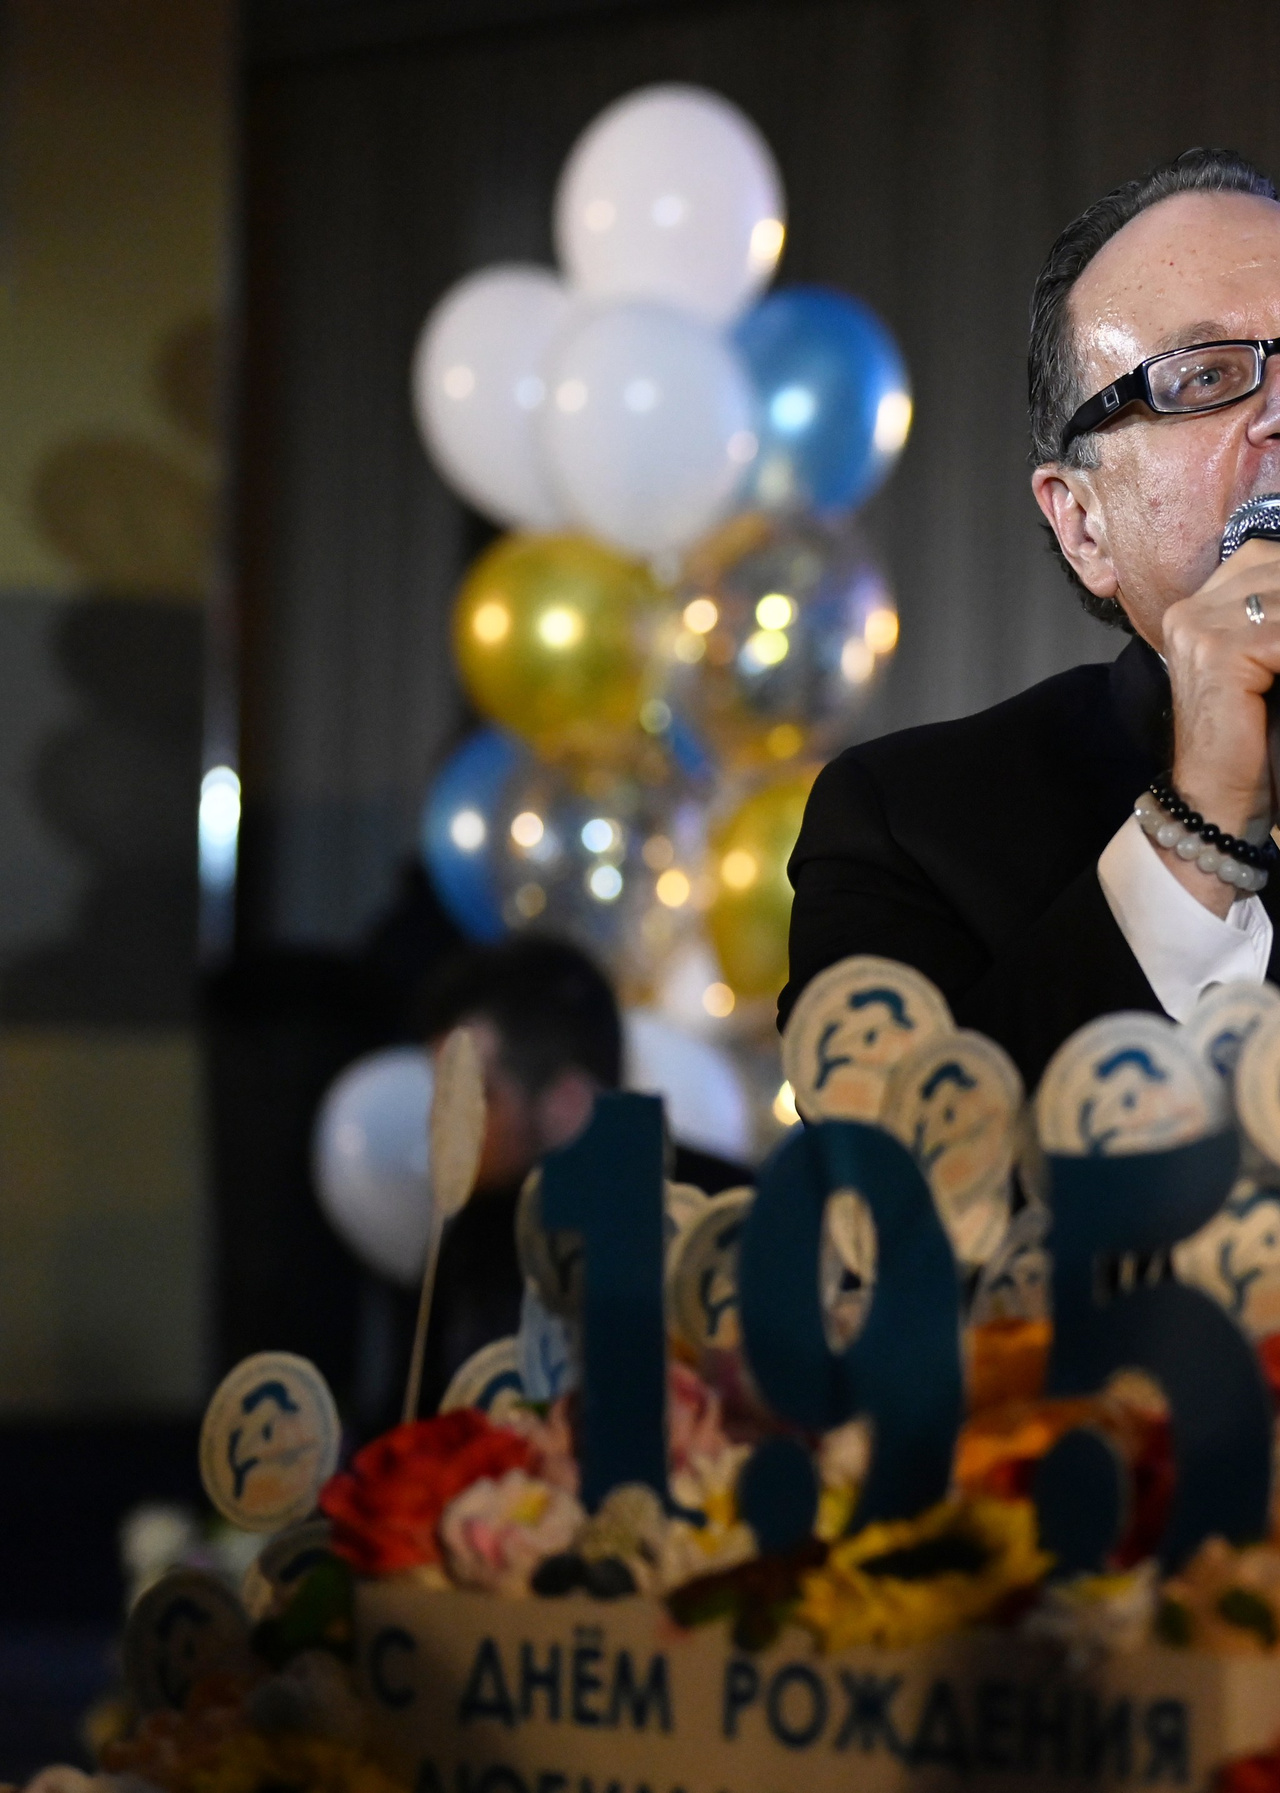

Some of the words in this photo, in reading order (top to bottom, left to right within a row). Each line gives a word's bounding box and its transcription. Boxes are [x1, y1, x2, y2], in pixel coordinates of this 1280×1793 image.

[369, 1626, 415, 1709] С
[459, 1625, 673, 1733] ДНЁМ
[723, 1657, 1191, 1785] РОЖДЕНИЯ
